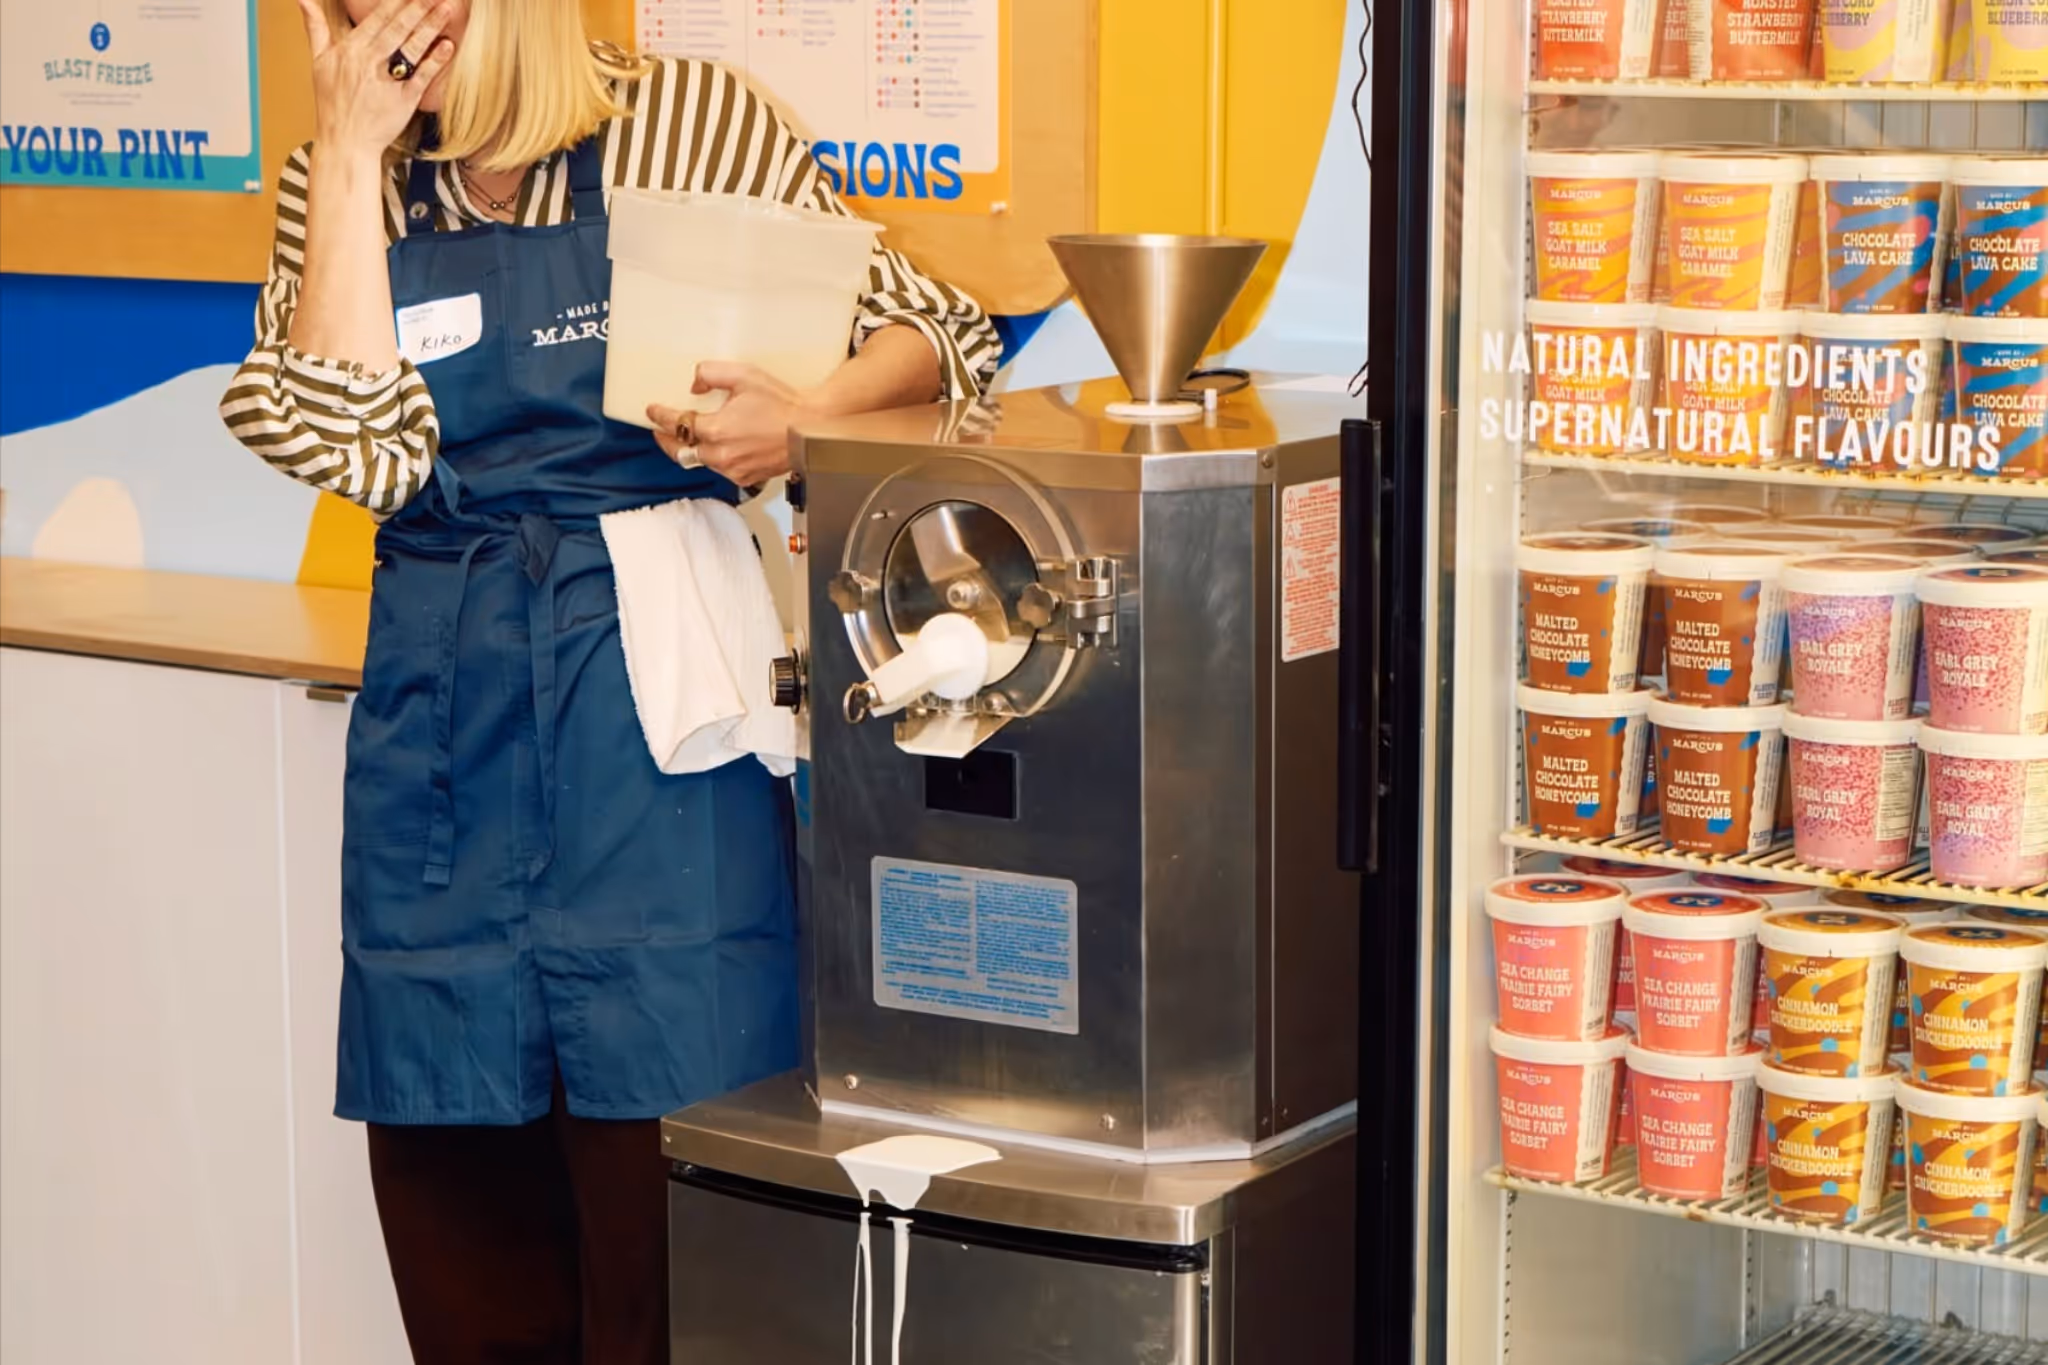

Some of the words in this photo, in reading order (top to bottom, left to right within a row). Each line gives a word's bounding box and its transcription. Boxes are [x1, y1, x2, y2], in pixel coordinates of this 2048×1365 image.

[1988, 11, 2048, 25] BLUEBERR
[1729, 29, 1800, 44] BUTTERMILK
[44, 58, 92, 81] BLAST
[97, 62, 153, 85] FREEZE
[2, 125, 108, 176] YOUR
[117, 128, 209, 180] PINT
[805, 140, 963, 201] SIONS
[1852, 196, 1909, 209] MARCUS
[1976, 201, 2030, 214] MARCUS
[1548, 221, 1568, 235] SEA
[1572, 222, 1603, 236] SALT
[1680, 227, 1701, 241] SEA
[1704, 228, 1736, 243] SALT
[1546, 237, 1572, 252] GOAT
[1576, 239, 1607, 254] MILK
[1842, 233, 1916, 248] CHOCOLATE
[1970, 238, 2040, 253] CHOCOLATE
[1679, 244, 1704, 259] GOAT
[1707, 246, 1739, 260] MILK
[1844, 251, 1875, 265] LAVA
[1879, 252, 1914, 266] CAKE
[1549, 255, 1601, 271] CARAMEL
[1681, 261, 1733, 277] CARAMEL
[1971, 256, 1999, 270] LAVA
[2002, 257, 2038, 271] CAKE
[566, 302, 598, 320] MADE
[1482, 331, 1651, 380] NATURAL
[1670, 338, 1928, 394] INGREDIENTS
[1981, 357, 2038, 371] MARCUS
[1546, 385, 1570, 400] GOAT
[1575, 388, 1604, 402] MILK
[1682, 393, 1709, 410] GOAT
[1714, 395, 1745, 411] MILK
[1822, 388, 1891, 405] CHOCOLATE
[1972, 393, 2047, 410] CHOCOLATE
[1854, 407, 1890, 422] CAKE
[1974, 411, 2004, 427] LAVA
[2008, 413, 2044, 428] CAKE
[1480, 398, 1774, 459] SUPERNATURAL
[1794, 415, 2000, 471] FLAVOURS
[1533, 582, 1580, 597] MARCUS
[1675, 589, 1723, 603] MARCUS
[1536, 613, 1578, 631] MALTED
[1676, 620, 1720, 638] MALTED
[1530, 628, 1589, 648] CHOCOLATE
[1670, 636, 1731, 655] CHOCOLATE
[1530, 643, 1591, 664] HONEYCOMB
[1800, 640, 1826, 657] EARL
[1828, 643, 1862, 659] GREY
[1670, 652, 1732, 671] HONEYCOMB
[1807, 658, 1853, 675] ROYALE
[1935, 651, 1962, 669] EARL
[1963, 655, 1998, 671] GREY
[1943, 669, 1988, 688] ROYALE
[1542, 725, 1591, 740] MARCUS
[1673, 738, 1724, 754] MARCUS
[1543, 755, 1589, 773] MALTED
[1535, 770, 1599, 789] CHOCOLATE
[1674, 769, 1720, 787] MALTED
[1534, 785, 1600, 805] HONEYCOMB
[1667, 785, 1731, 804] CHOCOLATE
[1823, 789, 1858, 805] GREY
[1666, 800, 1733, 820] HONEYCOMB
[1807, 804, 1842, 821] ROYAL
[1966, 804, 2001, 820] GREY
[1947, 820, 1985, 837] ROYAL
[1508, 934, 1556, 950] MARCUS
[1653, 948, 1705, 964] MARCUS
[1501, 961, 1519, 978] SEA
[1520, 964, 1570, 981] CHANGE
[1500, 976, 1535, 996] PRAIRIE
[1538, 980, 1574, 998] FAIRY
[1644, 977, 1663, 994] SEA
[1665, 980, 1718, 996] CHANGE
[1512, 997, 1554, 1013] SORBET
[1642, 992, 1681, 1011] PRAIRIE
[1684, 996, 1721, 1012] FAIRY
[1777, 995, 1839, 1016] CINNAMON
[1656, 1013, 1701, 1029] SORBET
[1771, 1009, 1853, 1033] SNICKERDOODLE
[1923, 1011, 1989, 1032] CINNAMON
[1915, 1026, 2002, 1050] SNICKERDOODLE
[1506, 1069, 1552, 1085] MARCUS
[1650, 1088, 1701, 1103] MARCUS
[1501, 1096, 1516, 1112] SEA
[1517, 1101, 1565, 1119] CHANGE
[1533, 1118, 1568, 1136] FAIRY
[1641, 1115, 1659, 1131] SEA
[1661, 1119, 1714, 1137] CHANGE
[1510, 1131, 1549, 1150] SORBET
[1640, 1130, 1677, 1151] PRAIRIE
[1680, 1135, 1717, 1153] FAIRY
[1777, 1138, 1840, 1160] CINNAMON
[1652, 1150, 1696, 1168] SORBET
[1770, 1151, 1854, 1177] SNICKERDOODLE
[1924, 1161, 1991, 1181] CINNAMON
